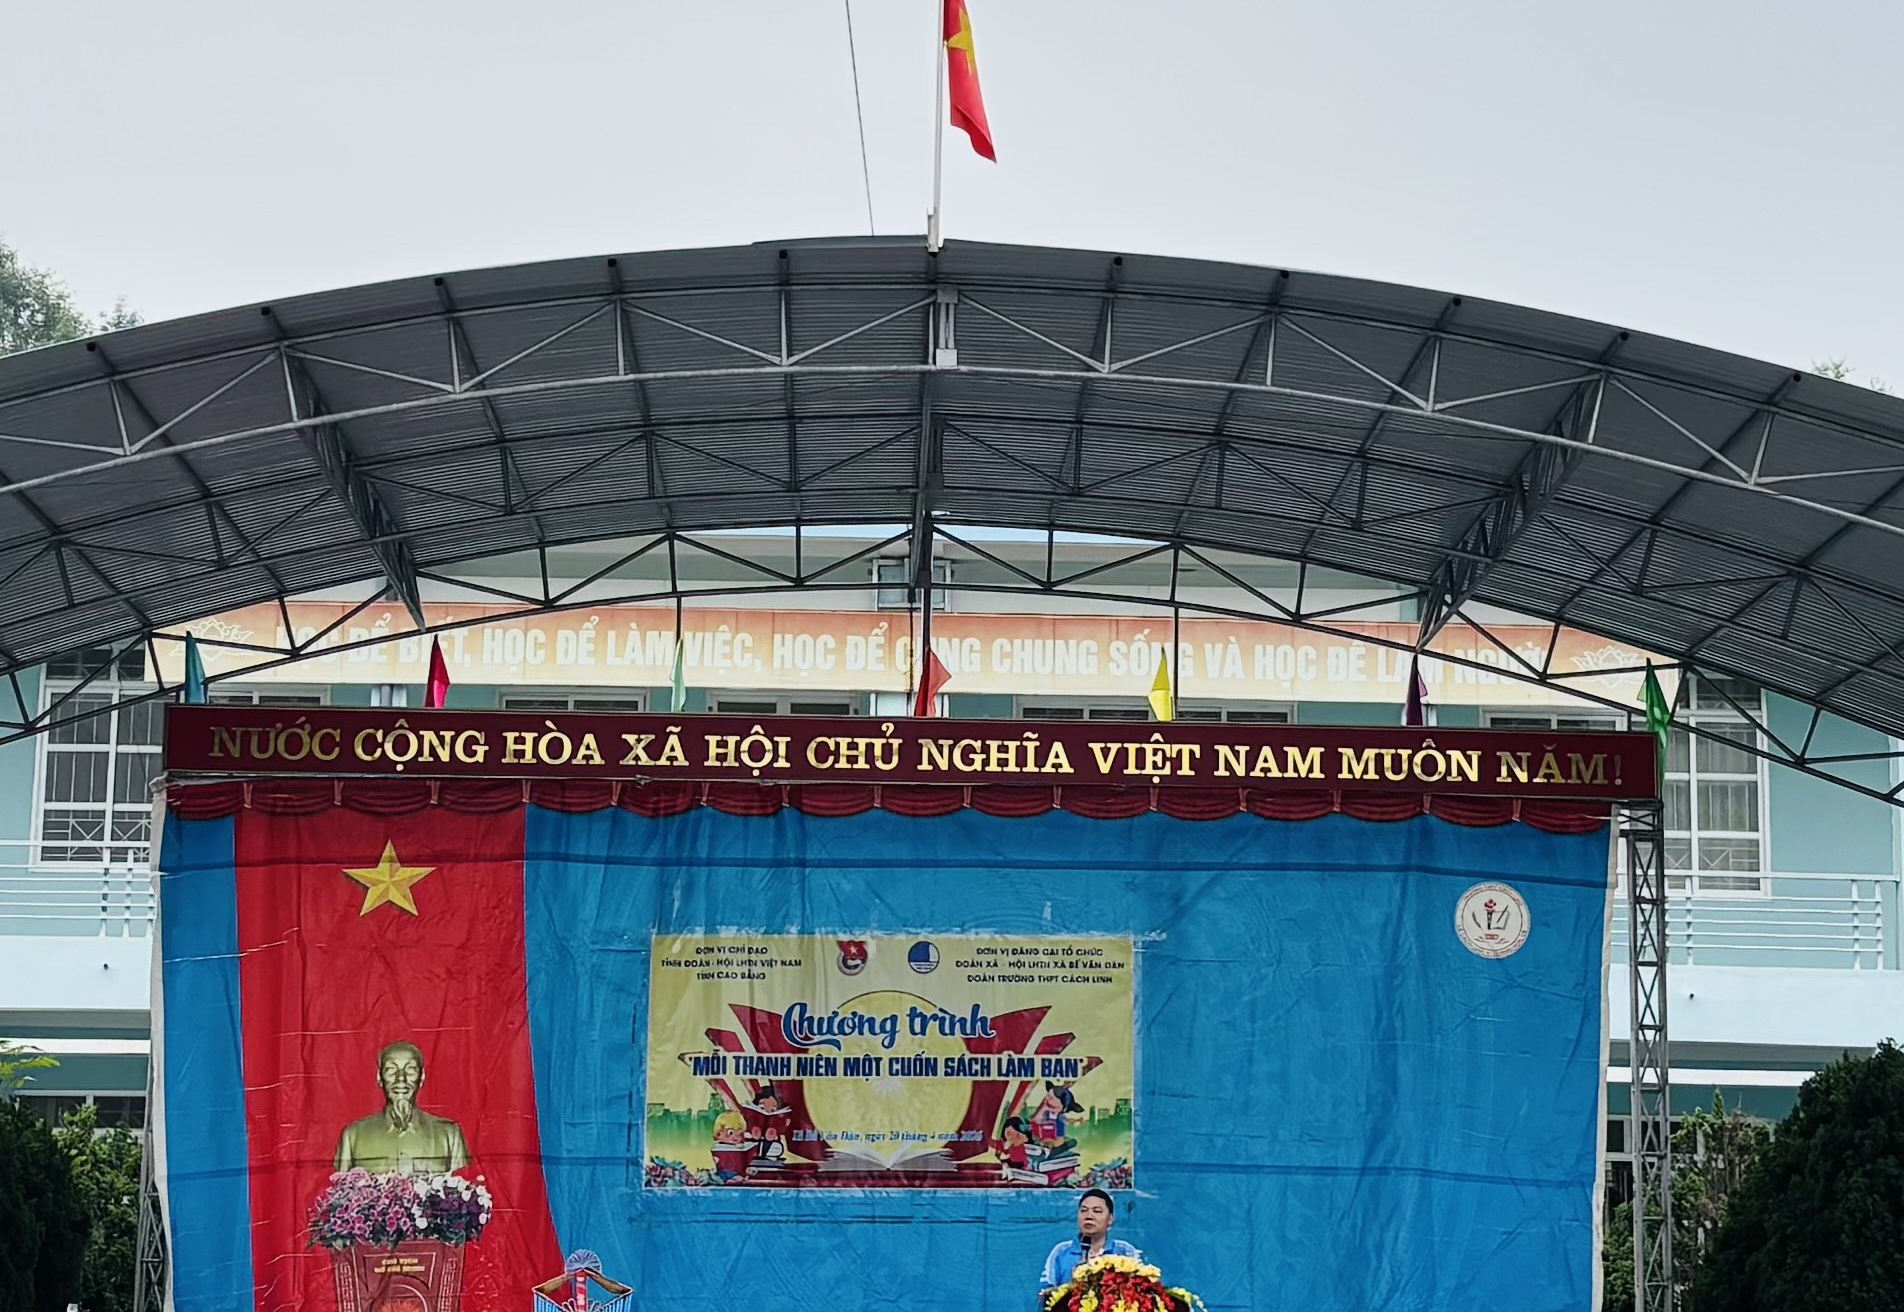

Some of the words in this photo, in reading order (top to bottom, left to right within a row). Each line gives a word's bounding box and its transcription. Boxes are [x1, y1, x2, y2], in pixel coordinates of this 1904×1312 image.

[483, 627, 546, 673] HỌC
[556, 615, 600, 666] ĐỂ
[607, 622, 676, 667] LÀM
[682, 624, 763, 675] VIỆC,
[773, 633, 836, 677] HỌC
[846, 621, 889, 672] ĐỂ
[992, 636, 1098, 676] CHUNG
[1203, 635, 1245, 680] VÀ
[1254, 643, 1317, 687] HỌC
[208, 715, 343, 762] NƯỚC
[353, 718, 490, 772] CỘNG
[501, 719, 605, 765] HÒA
[619, 725, 690, 768] XÃ
[703, 724, 791, 777] HỘI
[806, 722, 903, 772] CHỦ
[917, 732, 1075, 775] NGHĨA
[1088, 732, 1202, 785] VIỆT
[1213, 744, 1326, 780] NAM
[1336, 738, 1482, 783] MUÔN
[1496, 741, 1624, 786] NĂM!
[782, 1001, 900, 1051] Chương
[907, 1002, 996, 1039] trình
[733, 1055, 792, 1077] THANH
[796, 1053, 838, 1077] NIÊN
[843, 1053, 884, 1082] MỘT
[888, 1050, 938, 1077] CUỐN
[943, 1052, 992, 1078] SÁCH
[997, 1053, 1036, 1078] LÀM
